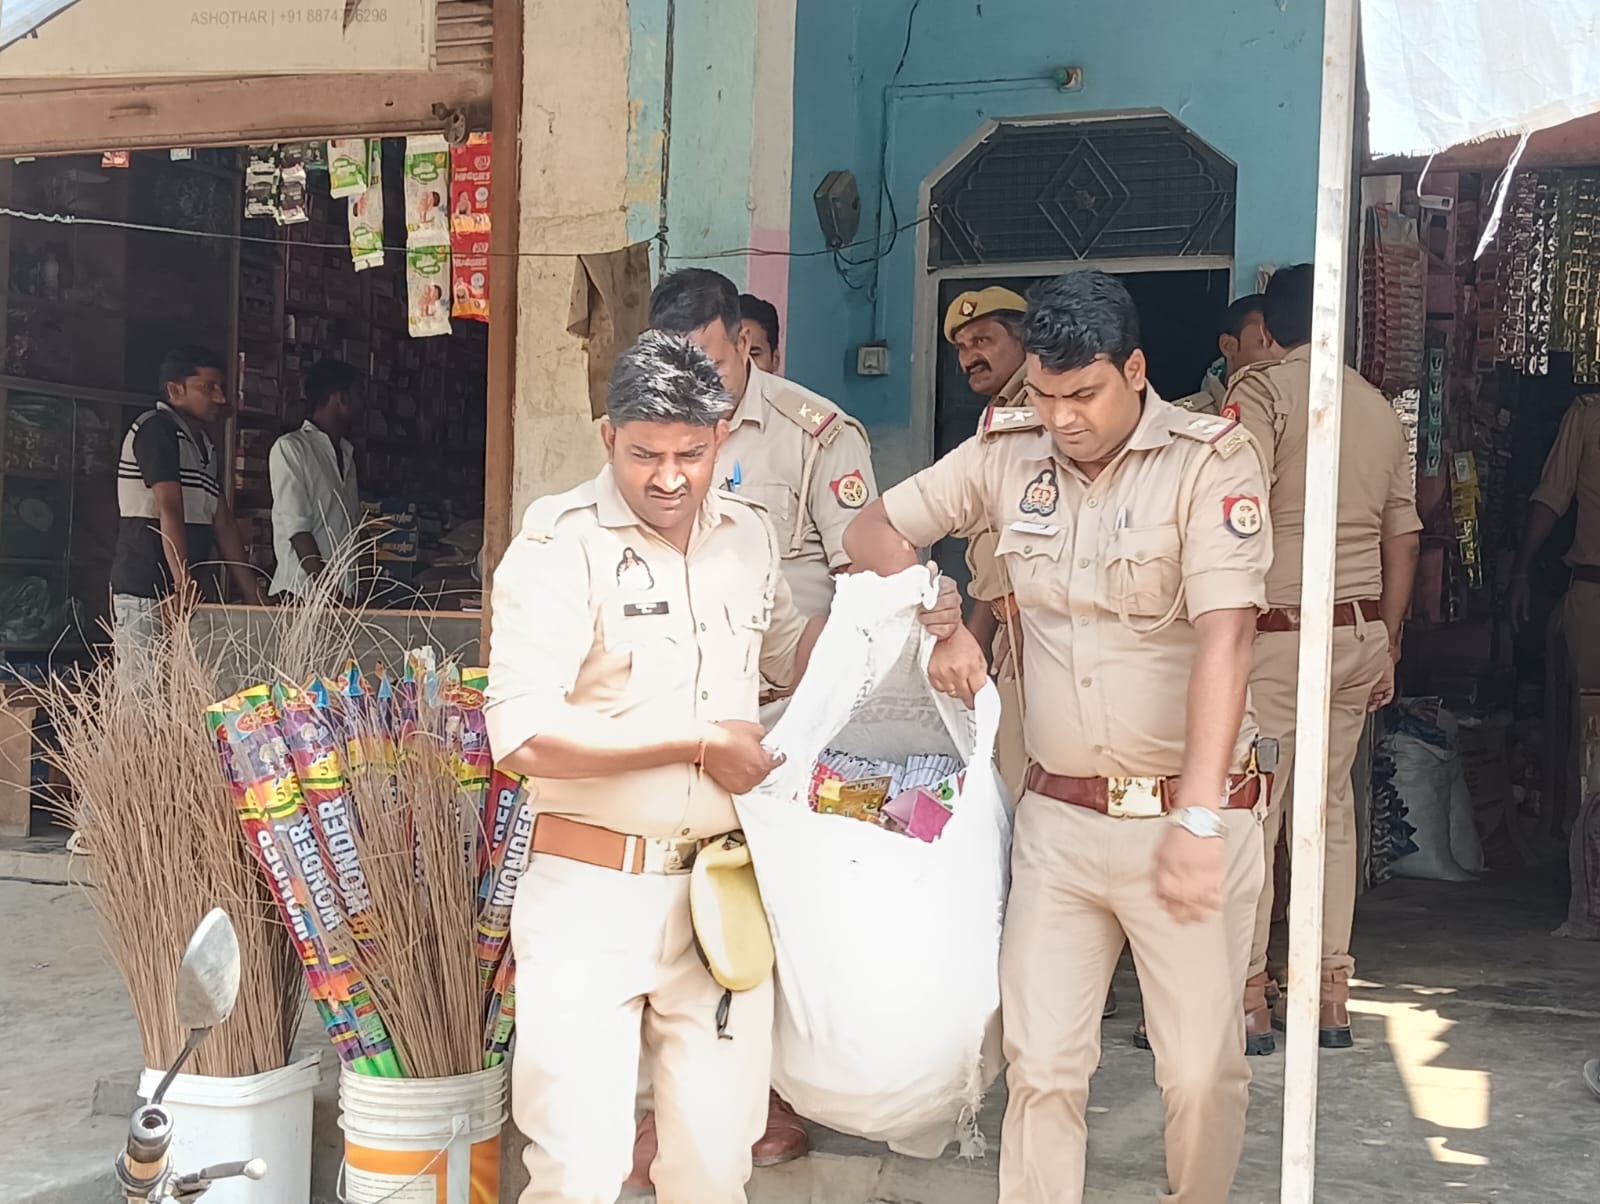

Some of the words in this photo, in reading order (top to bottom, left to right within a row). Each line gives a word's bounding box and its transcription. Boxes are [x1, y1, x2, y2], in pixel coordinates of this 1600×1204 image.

[190, 10, 267, 25] ASHOTHAR
[279, 9, 302, 23] +91
[306, 8, 388, 24] 88746298
[491, 803, 535, 908] WONDER
